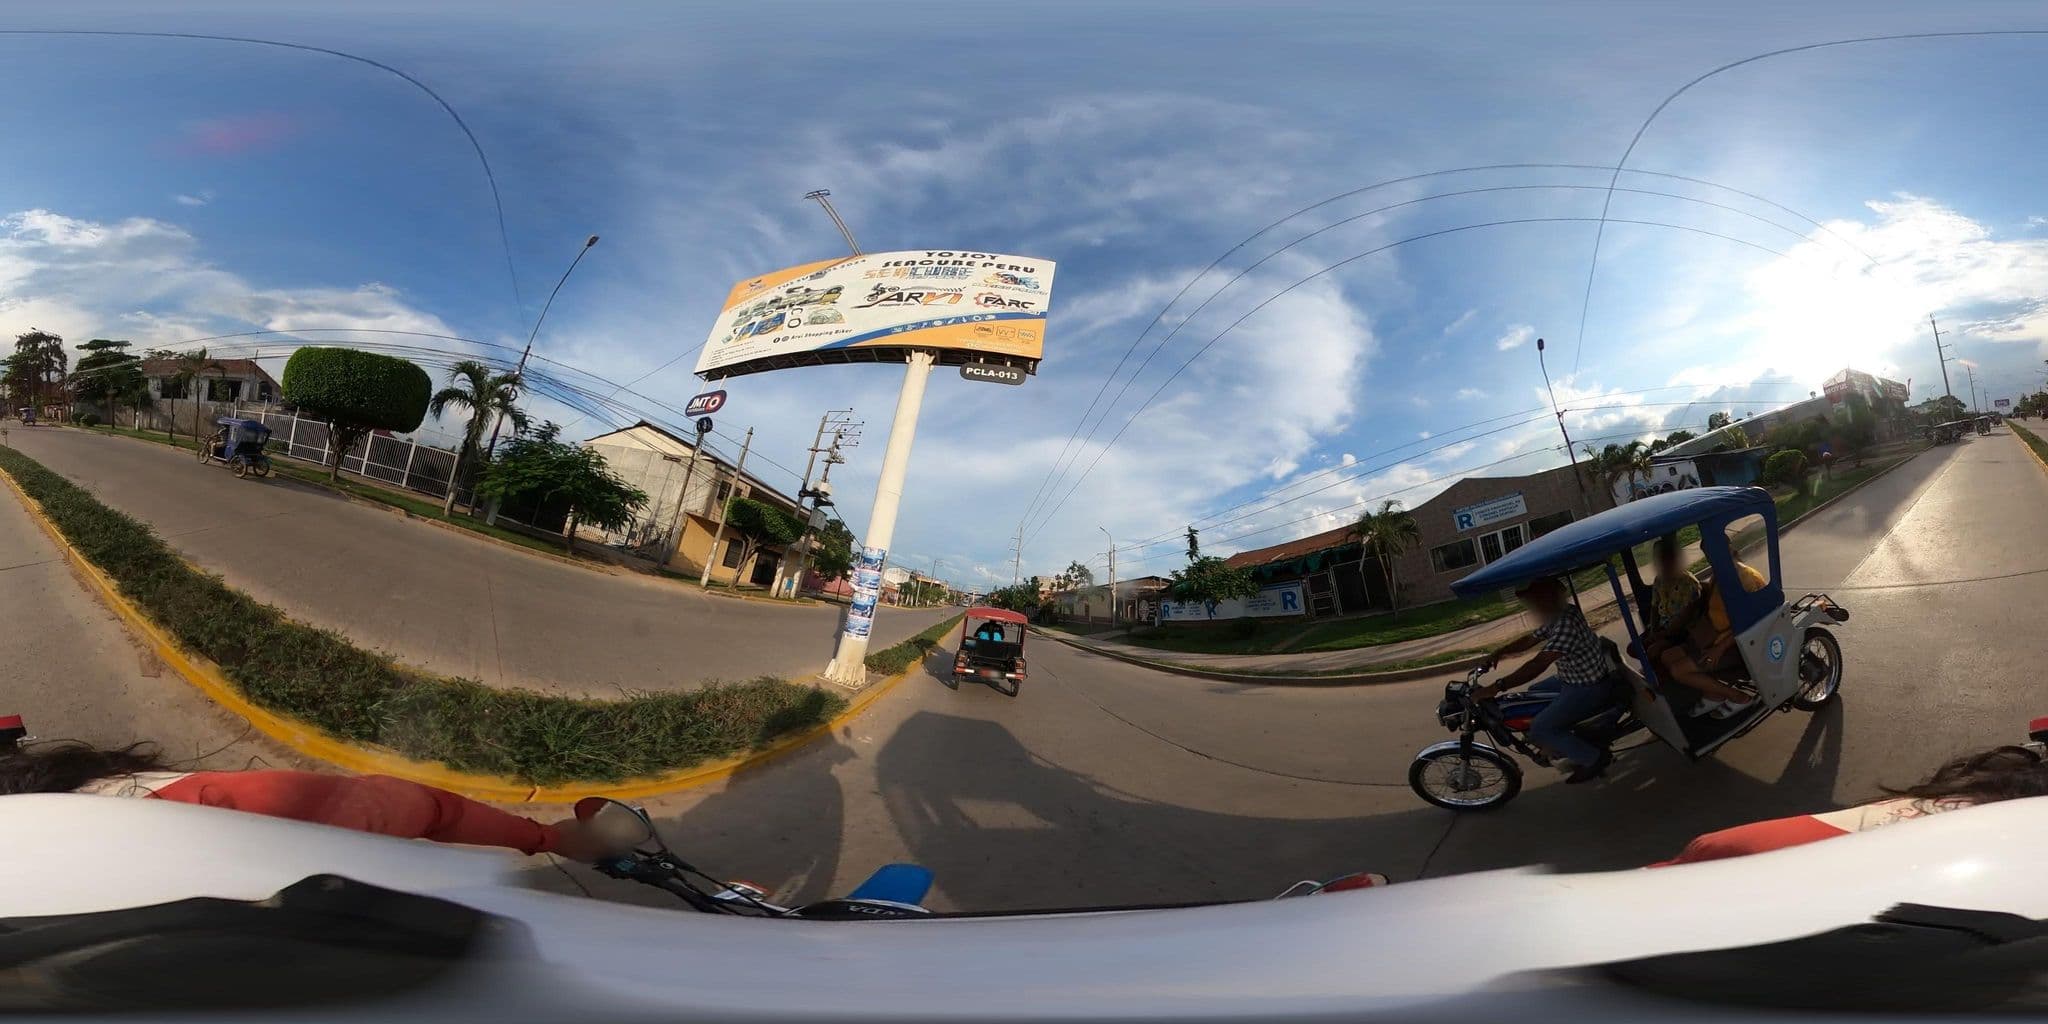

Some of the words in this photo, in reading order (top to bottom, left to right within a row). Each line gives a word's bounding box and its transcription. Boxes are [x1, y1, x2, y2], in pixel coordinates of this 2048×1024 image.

[982, 262, 1035, 273] PERU
[983, 296, 1036, 309] FARC
[966, 367, 1018, 380] PCLA-013
[1457, 513, 1474, 530] R
[1281, 591, 1298, 610] R
[1163, 604, 1170, 617] R
